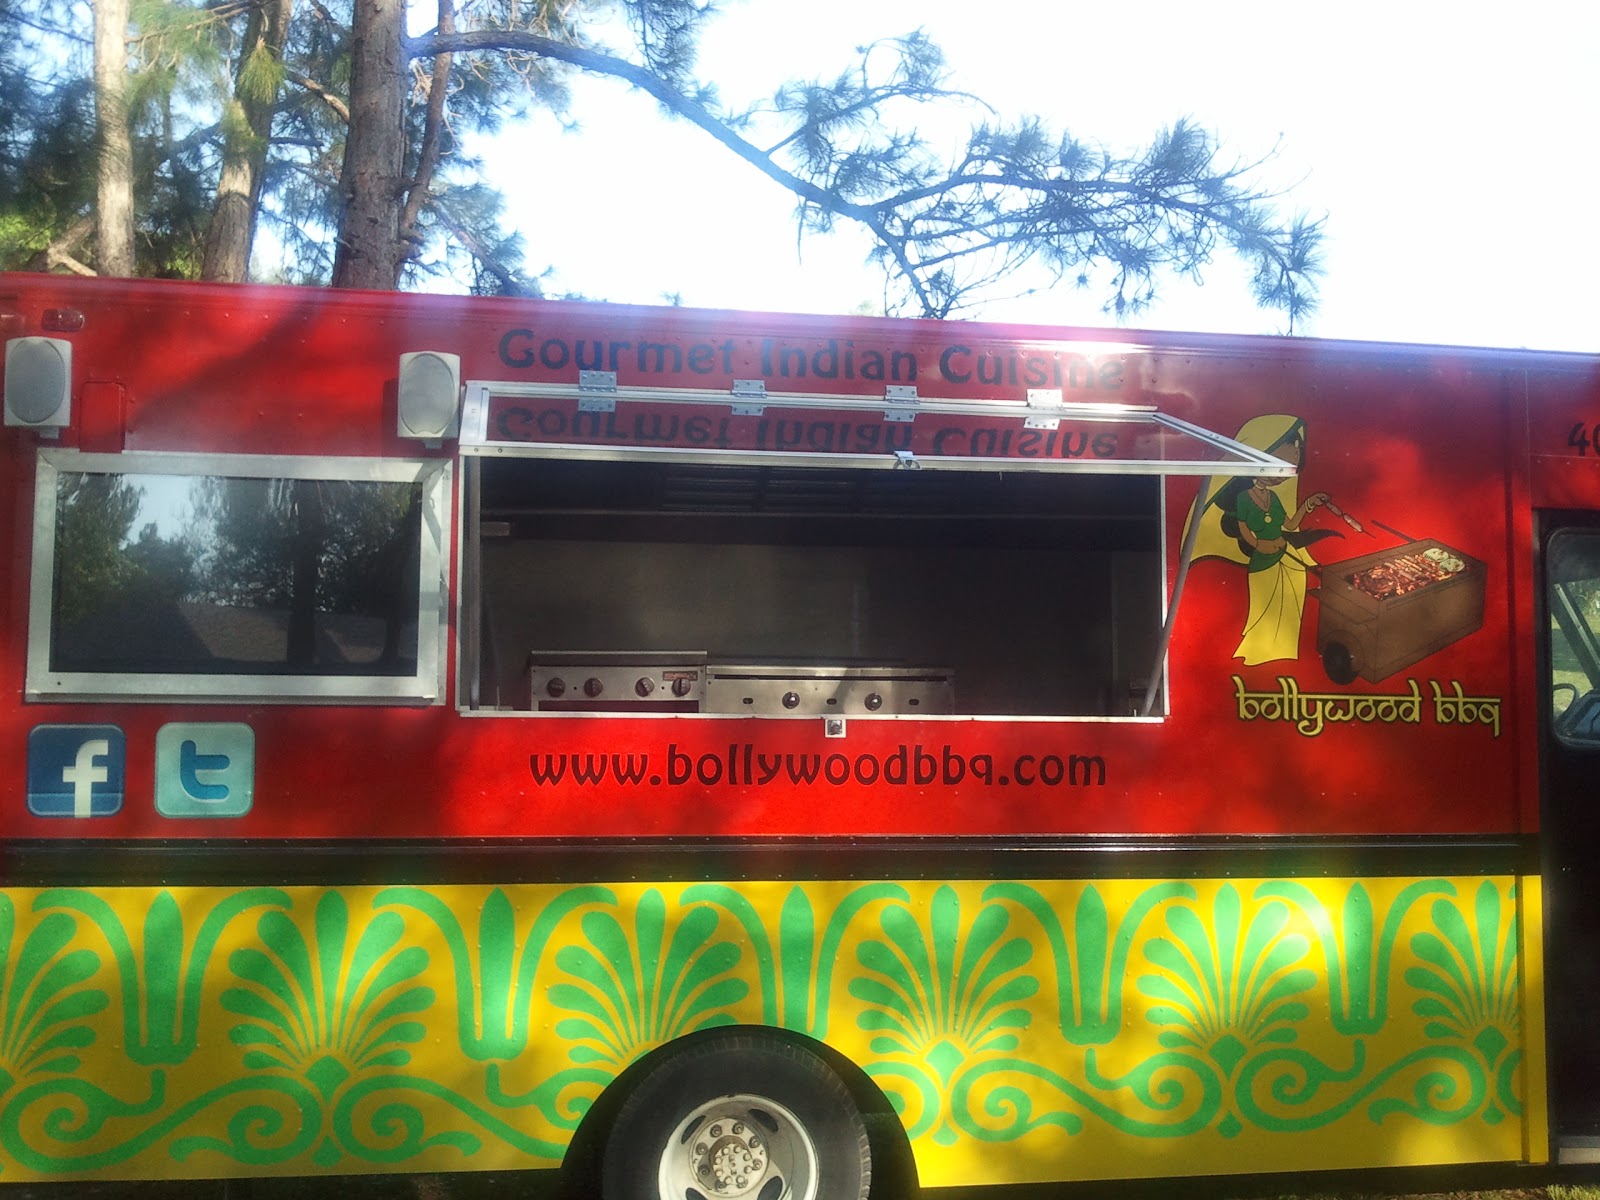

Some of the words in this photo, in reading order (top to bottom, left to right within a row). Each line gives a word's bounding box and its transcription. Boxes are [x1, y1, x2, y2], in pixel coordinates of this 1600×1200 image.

[499, 328, 735, 375] Gourmet
[760, 336, 918, 382] Indian
[939, 344, 1126, 390] Cuisine
[1231, 675, 1423, 737] bollywood
[1429, 680, 1502, 738] bbq
[529, 743, 1106, 787] www.bollywoodbbq.com
